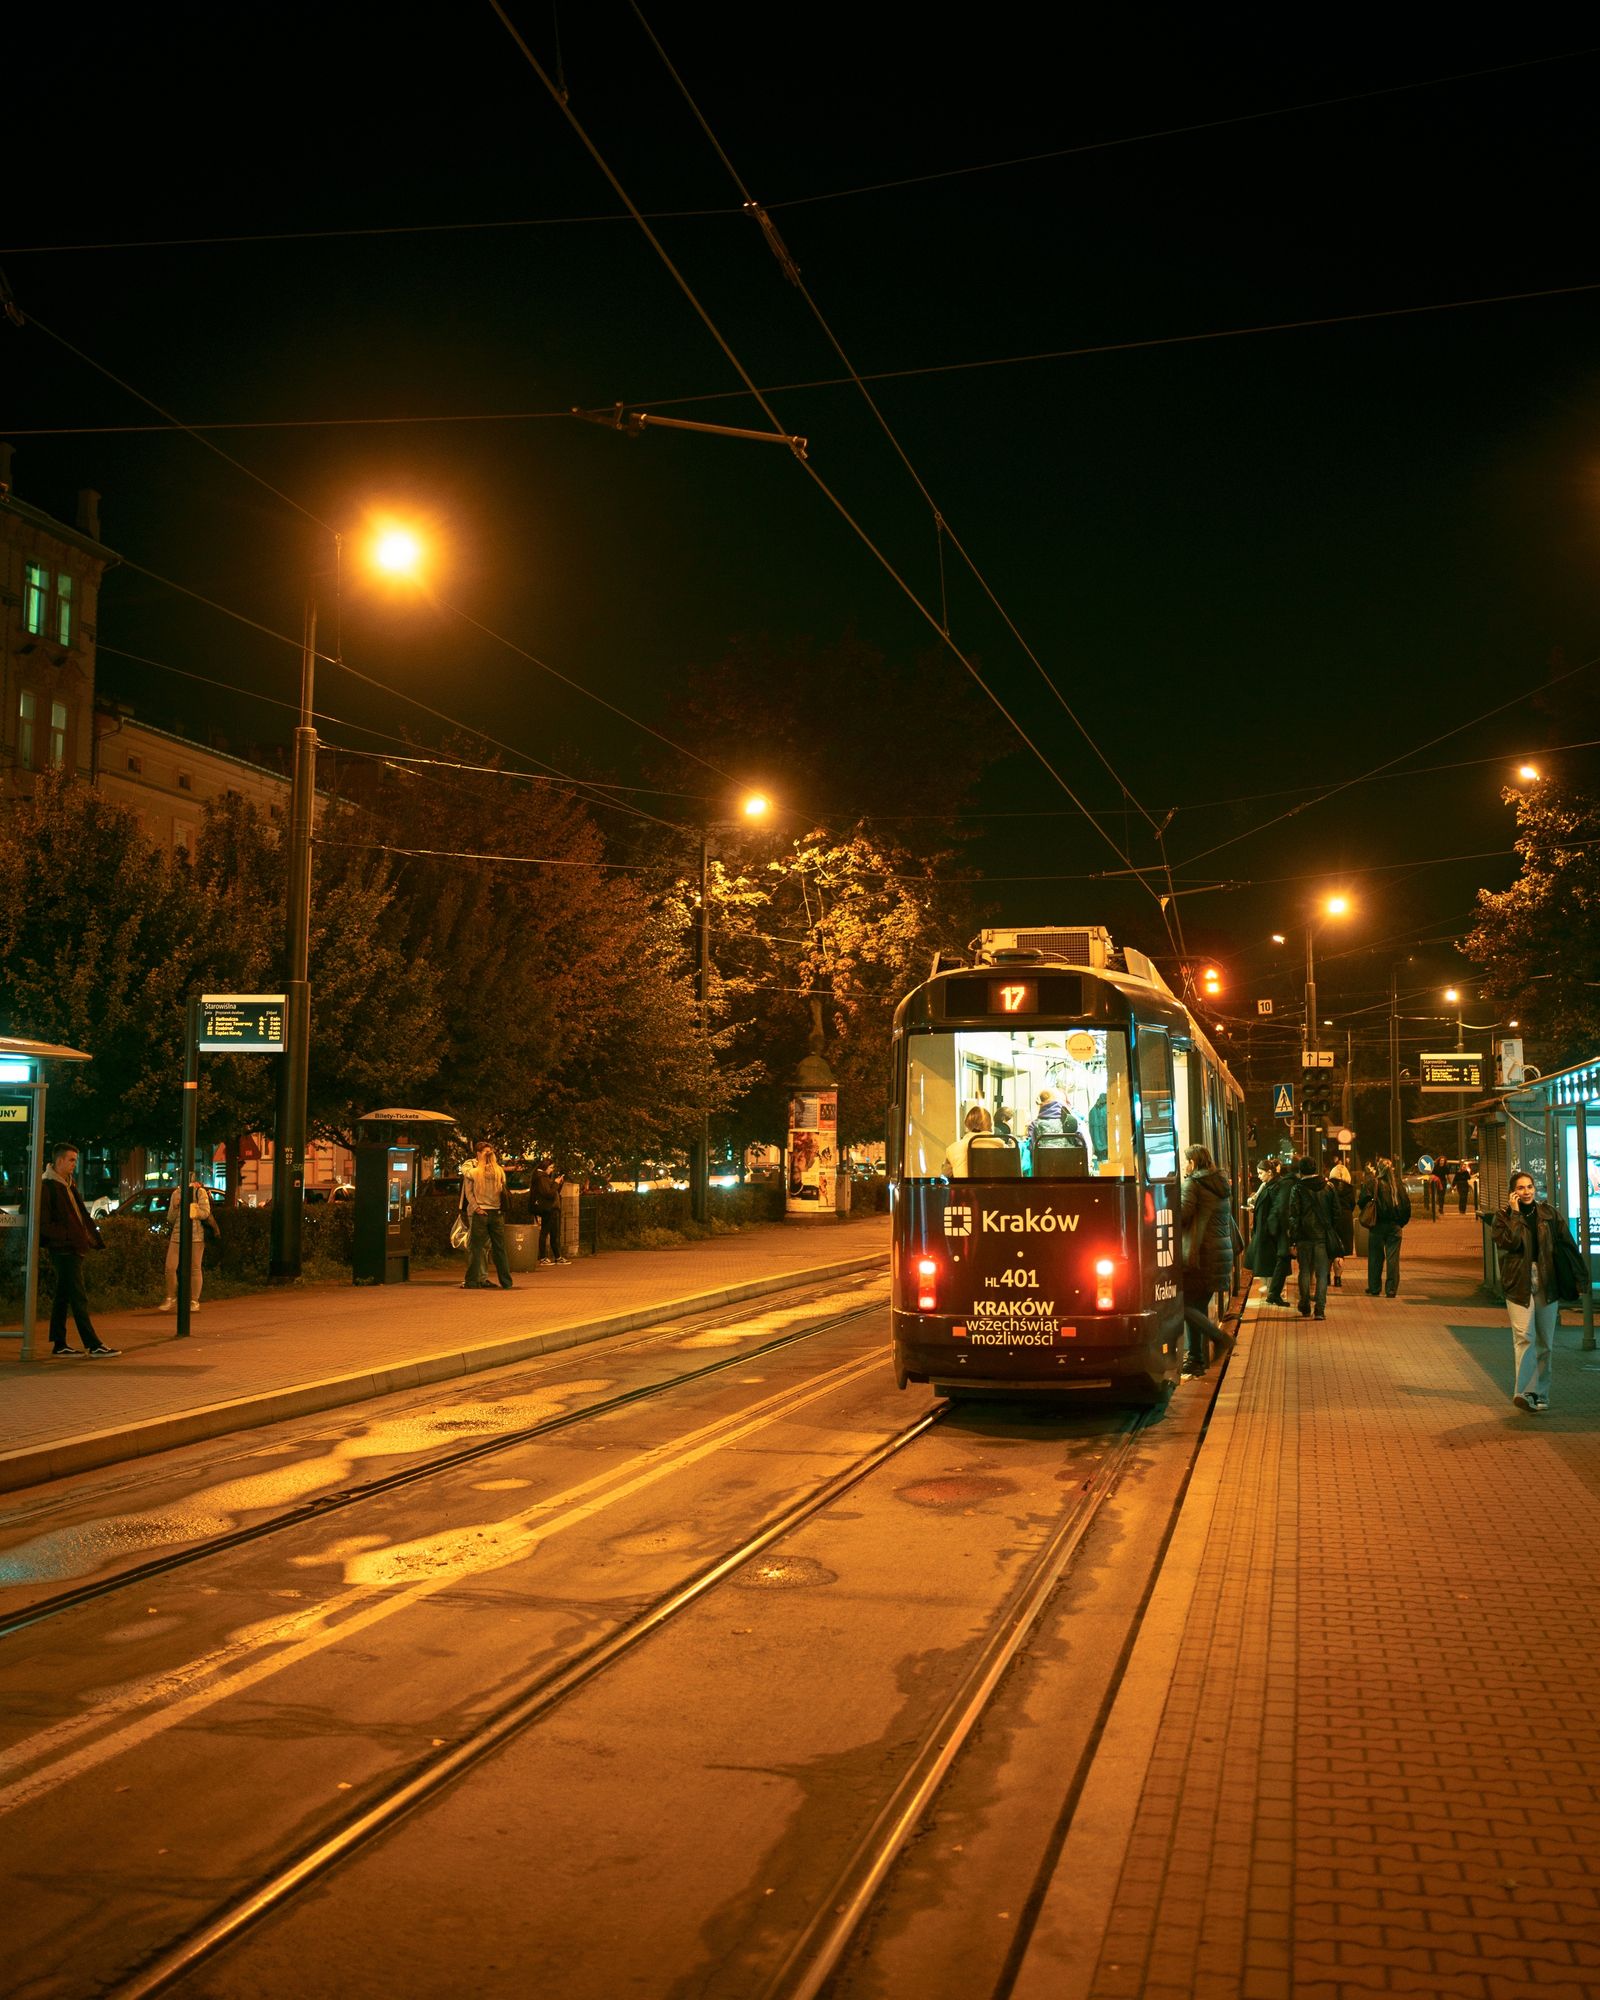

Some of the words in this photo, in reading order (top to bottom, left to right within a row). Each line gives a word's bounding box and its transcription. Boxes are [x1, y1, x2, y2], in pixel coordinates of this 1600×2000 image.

[1000, 986, 1025, 1010] 17
[1259, 1001, 1271, 1012] 10
[982, 1207, 1080, 1233] Kraków
[1155, 1280, 1177, 1301] Kraków
[973, 1297, 1055, 1316] KRAKÓW
[966, 1317, 1059, 1332] wszechświat
[971, 1331, 1054, 1346] możliwości
